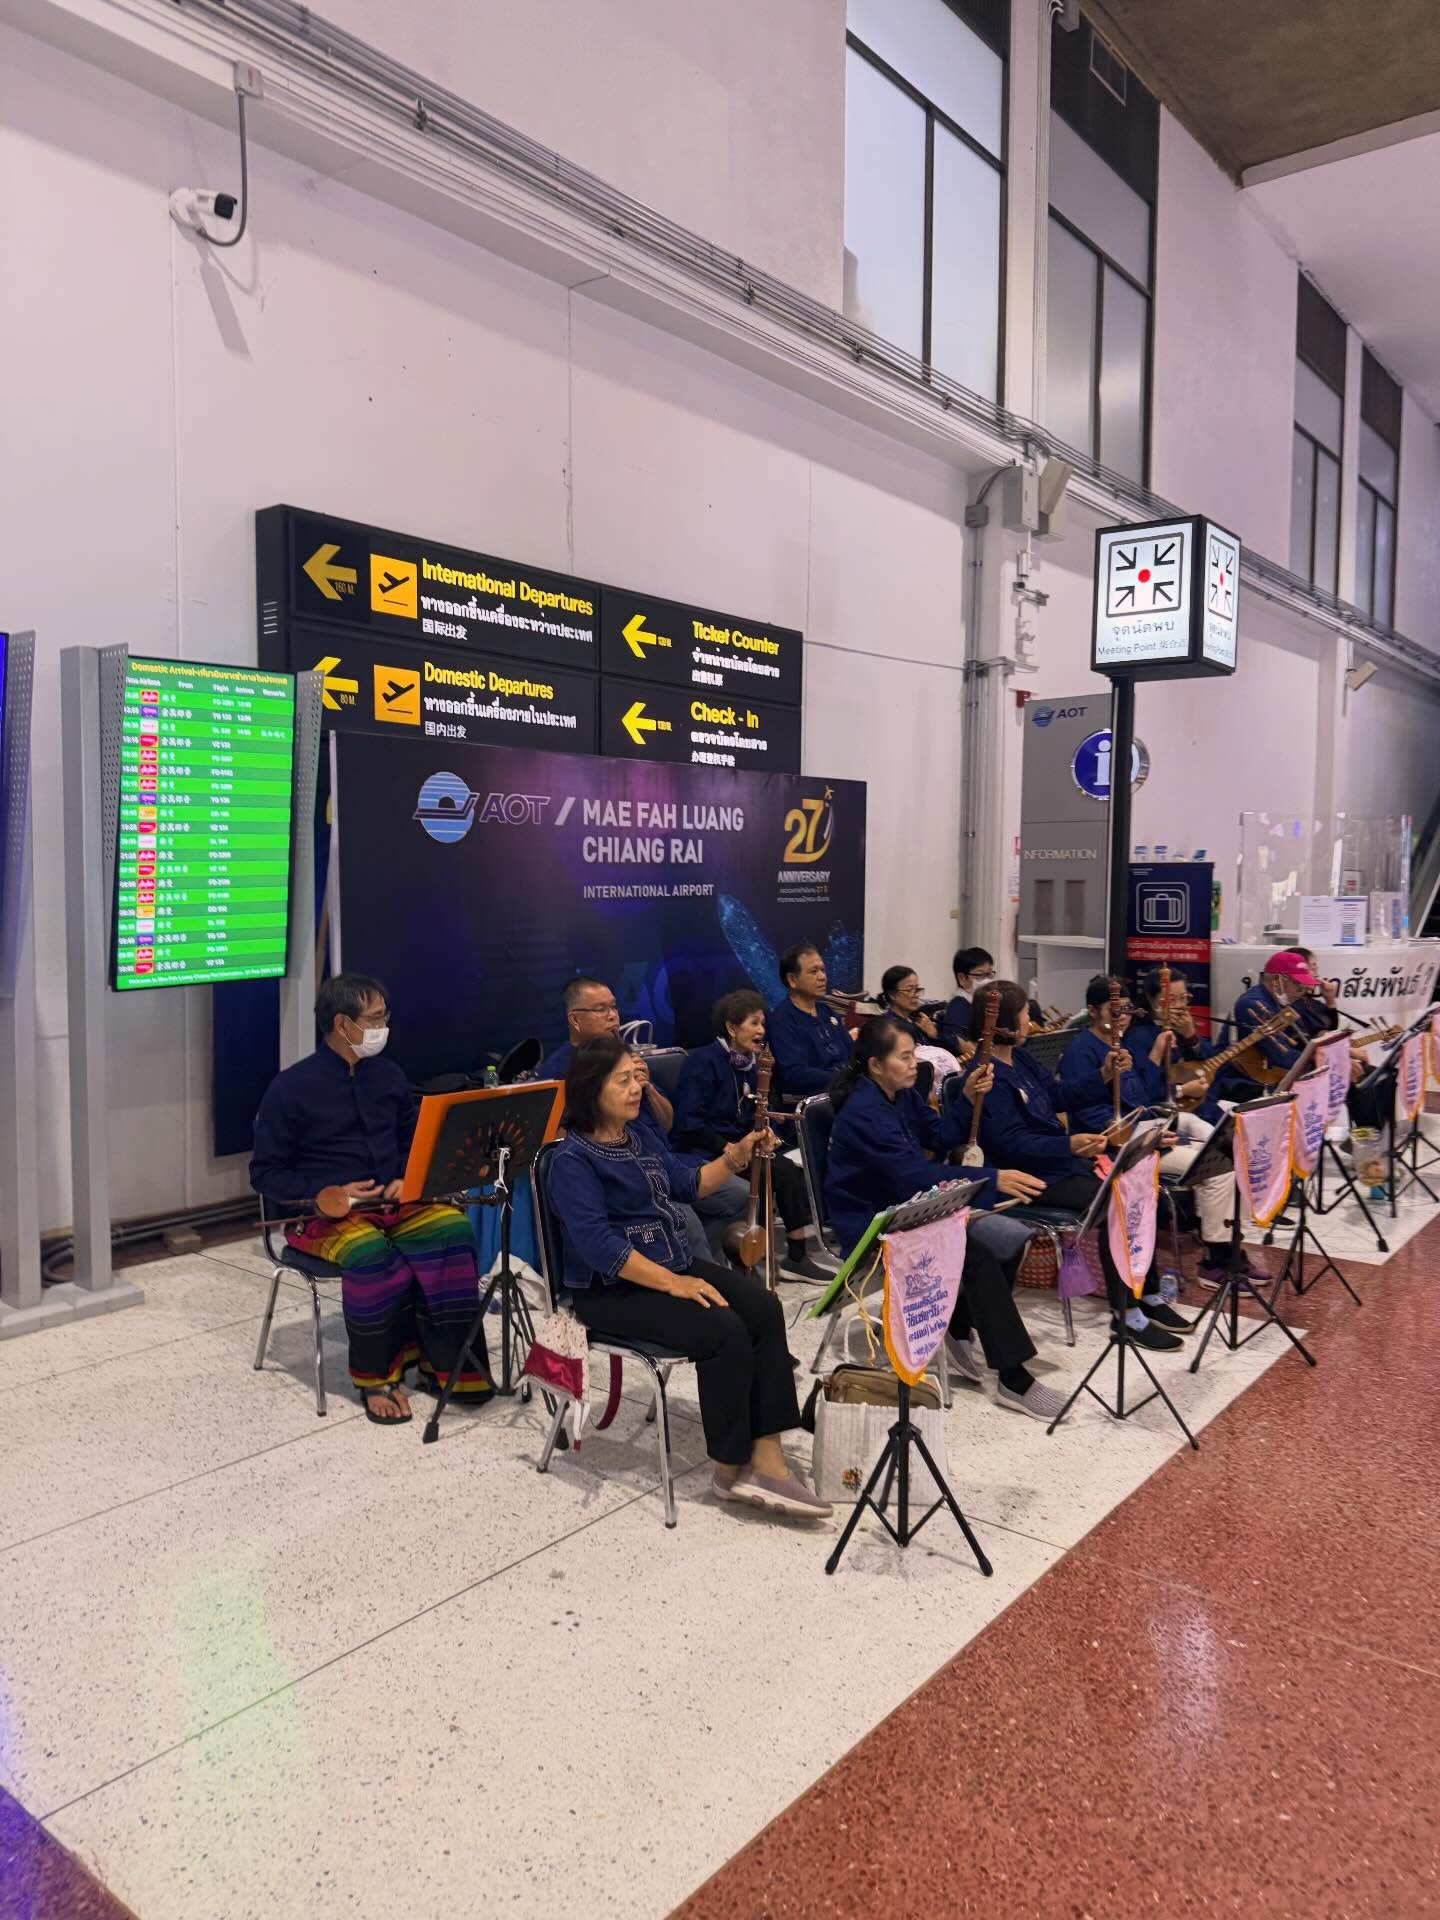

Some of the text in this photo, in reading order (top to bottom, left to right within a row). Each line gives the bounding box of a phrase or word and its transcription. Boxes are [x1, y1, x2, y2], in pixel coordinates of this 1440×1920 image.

[422, 558, 593, 616] International Departures
[420, 595, 592, 643] ทางออกขึ้นเครื่องระหว่างประเทศ
[422, 618, 467, 640] 国际出发
[1112, 619, 1174, 642] จุดนัดพบ
[692, 621, 779, 655] Ticket Counter
[1134, 643, 1156, 652] Point
[424, 661, 553, 700] Domestic Departures
[340, 694, 348, 704] 80
[424, 691, 577, 728] ทางออกขึ้นเครื่องภายในประเทศ
[691, 701, 736, 725] Check
[746, 710, 759, 728] In
[1057, 706, 1088, 719] AOT
[424, 721, 467, 739] 国内出发
[479, 793, 551, 825] AOT
[583, 799, 632, 827] MAE
[637, 802, 677, 829] FAH
[682, 804, 744, 831] LUANG
[582, 836, 703, 864] CHIANG RAI
[778, 870, 831, 883] ANNIVERSARY
[583, 884, 715, 899] INTERNATIONAL AIRPORT
